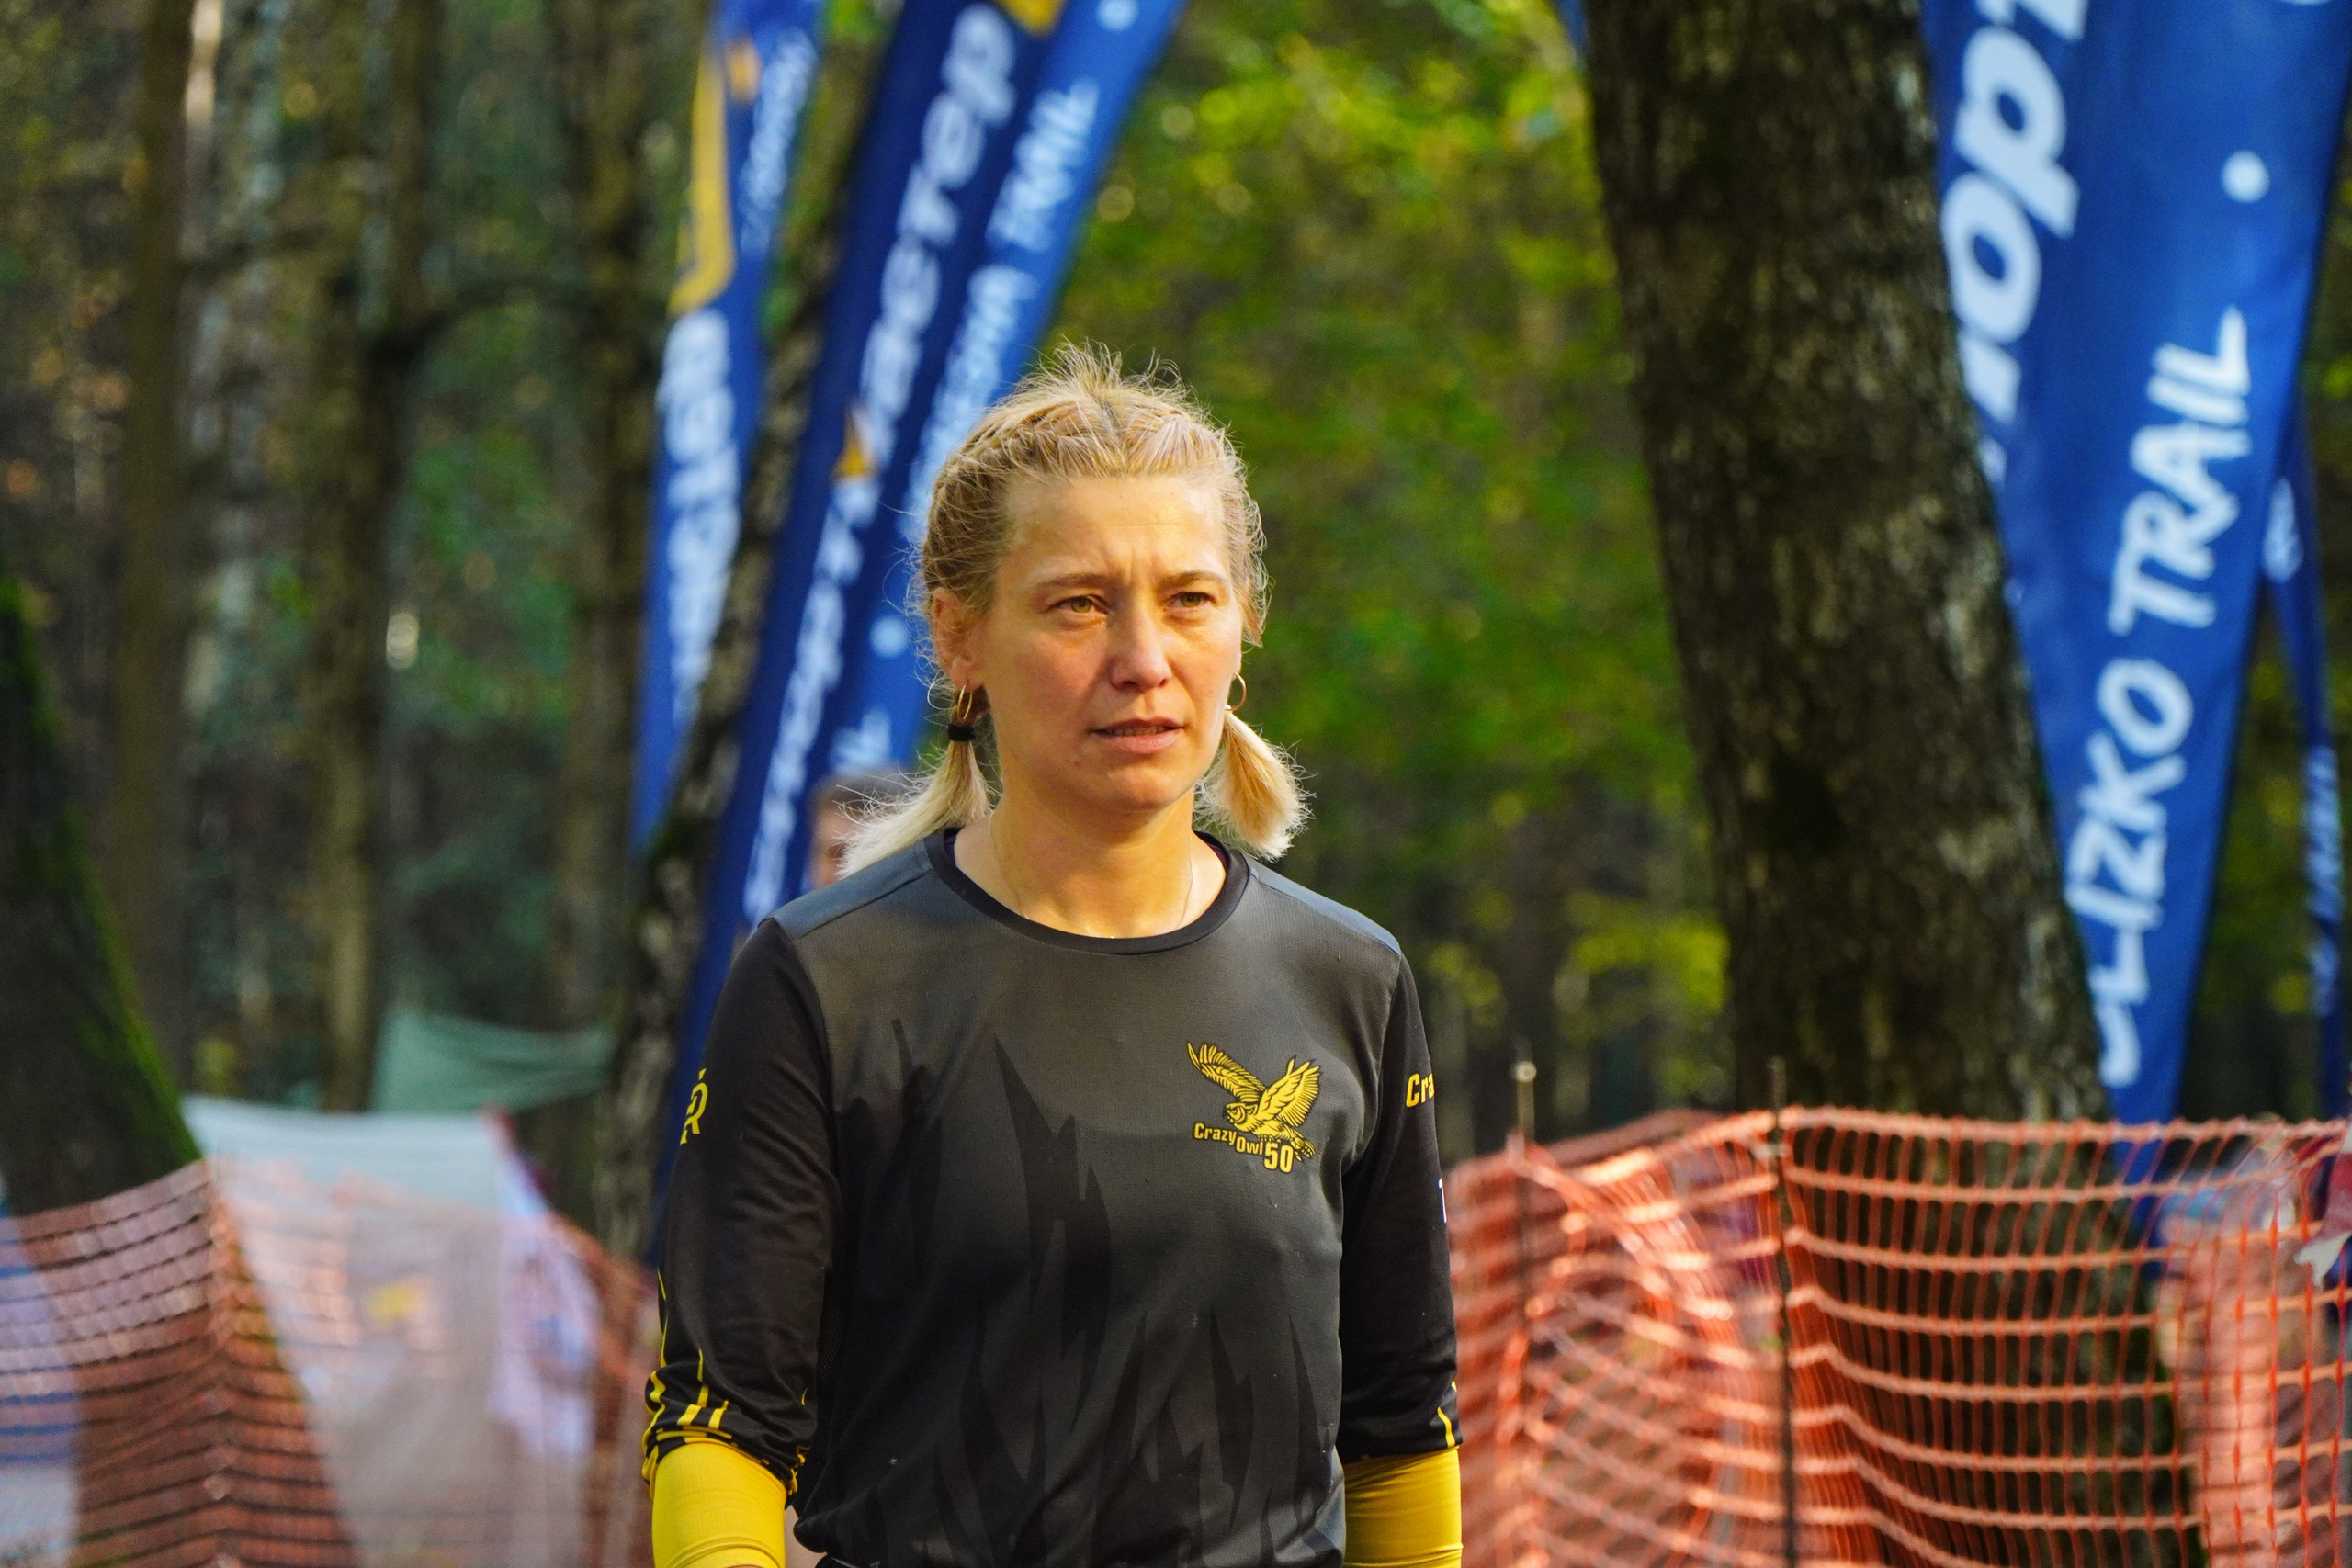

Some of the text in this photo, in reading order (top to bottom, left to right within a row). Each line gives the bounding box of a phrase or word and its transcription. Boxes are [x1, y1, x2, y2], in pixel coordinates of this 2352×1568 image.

[2107, 305, 2251, 635] TRAIL
[1193, 1122, 1295, 1174] Crazy Owl 50
